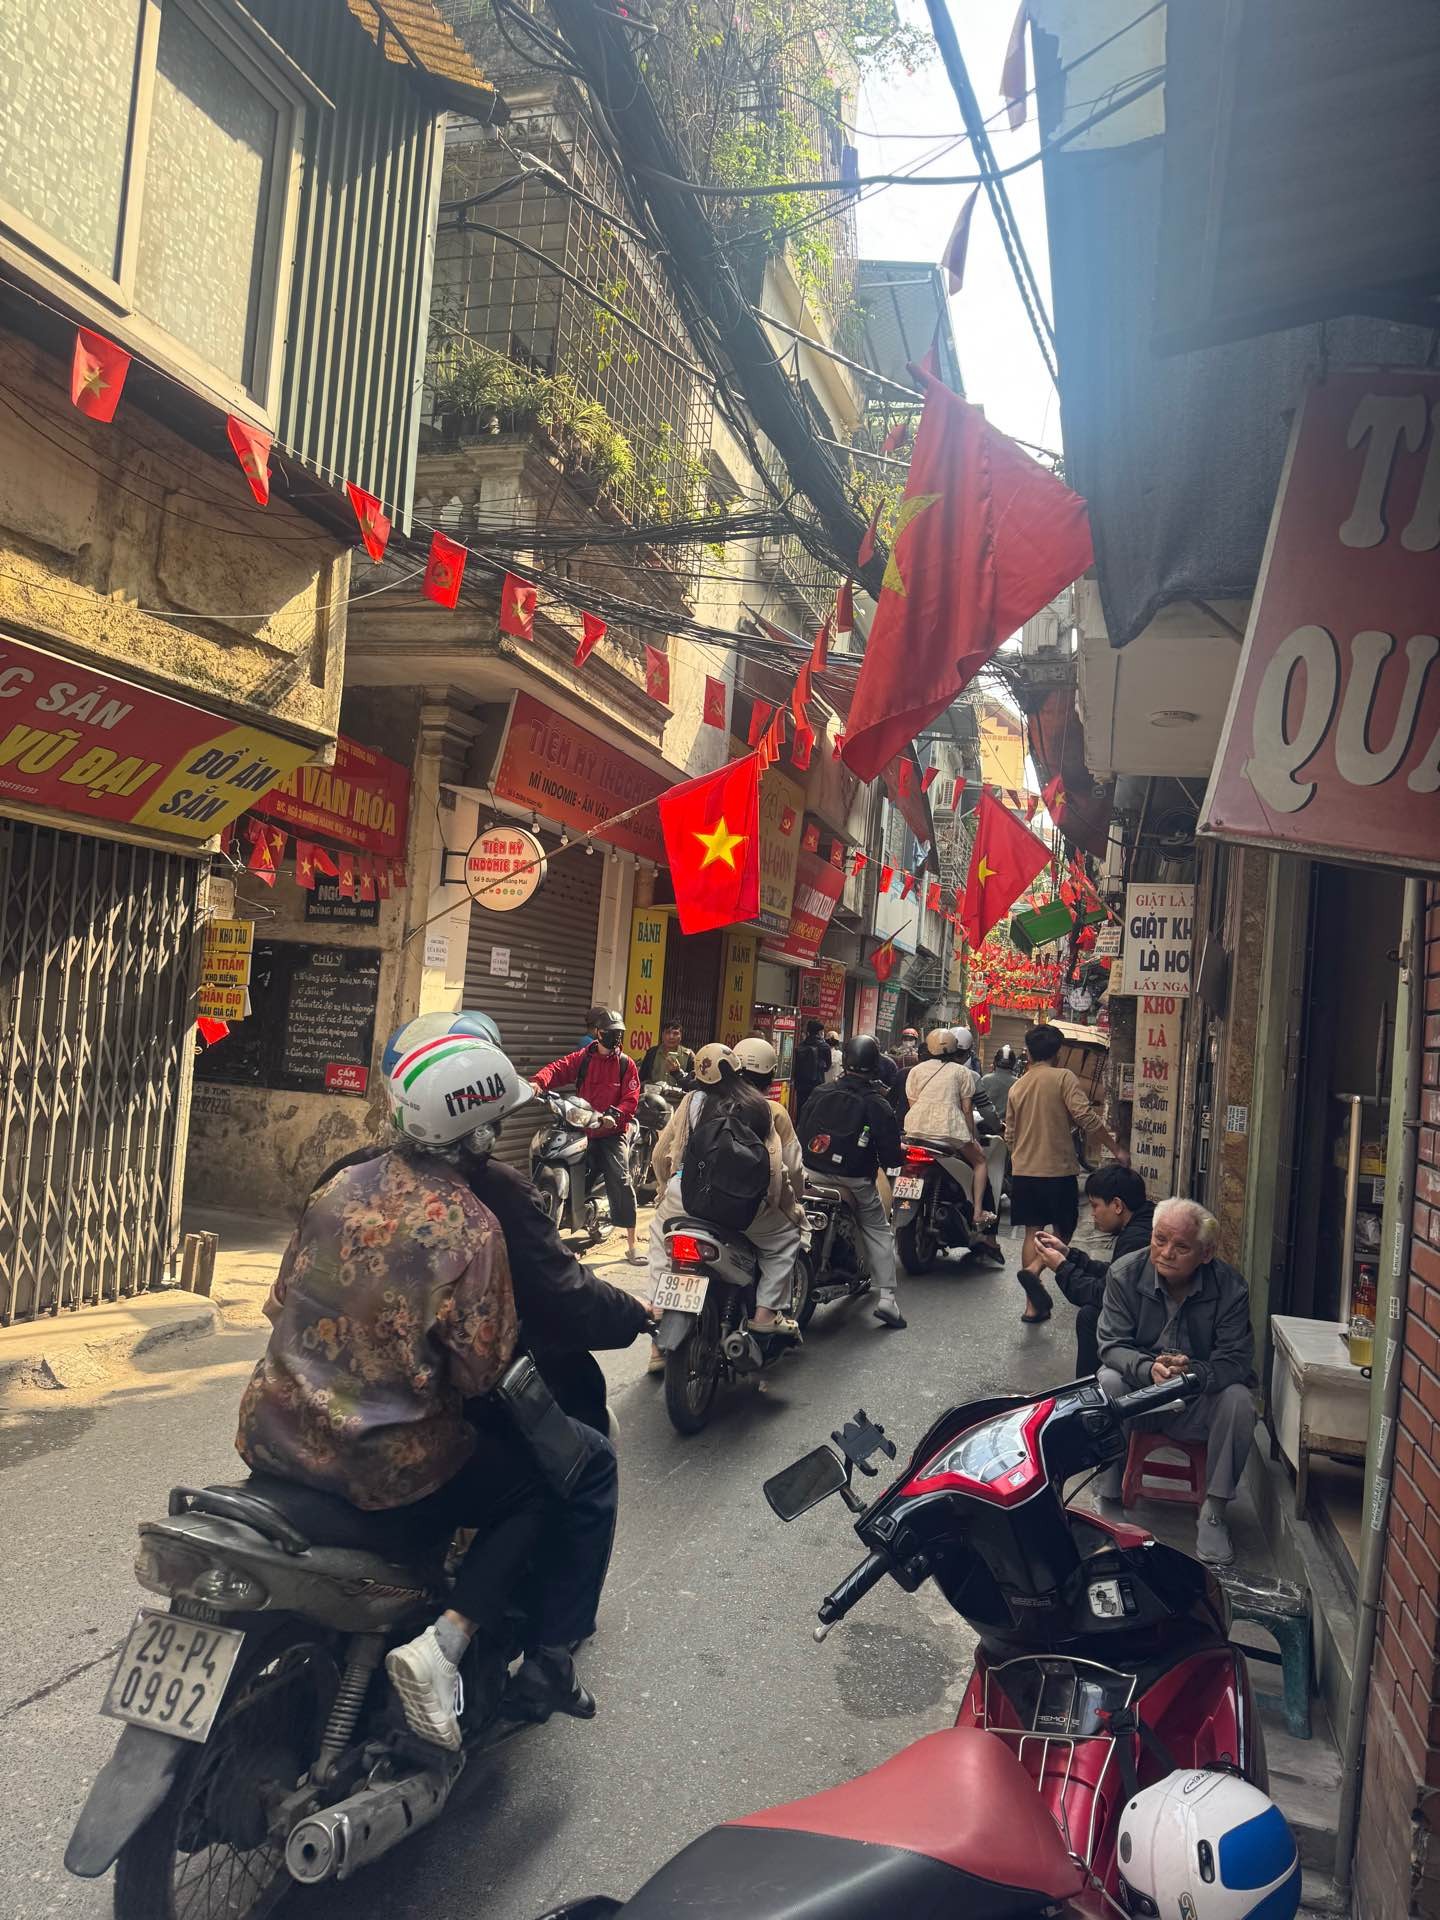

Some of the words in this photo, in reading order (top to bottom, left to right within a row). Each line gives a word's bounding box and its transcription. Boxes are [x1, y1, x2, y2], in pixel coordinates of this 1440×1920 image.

[36, 685, 135, 729] SẢN
[0, 724, 82, 774] VŨ
[59, 746, 163, 799] ĐẠI
[186, 748, 249, 780] ĐỒ
[226, 757, 280, 792] ĂN
[159, 785, 229, 822] SẴN
[528, 771, 540, 789] MÌ
[542, 779, 577, 807] INDOMIE
[581, 792, 594, 812] ĂN
[353, 788, 395, 836] HÓA
[1136, 892, 1166, 910] GIẶT
[1170, 892, 1186, 907] LÀ
[219, 927, 233, 943] KHO
[235, 926, 247, 944] TÀU
[637, 917, 661, 944] BÁNH
[1130, 912, 1168, 944] GIẶT
[1172, 917, 1193, 940] KH
[641, 953, 652, 978] MÌ
[1139, 944, 1160, 972] LÀ
[1165, 950, 1190, 973] HƠ
[1134, 977, 1160, 991] LẤY
[1162, 982, 1189, 992] NGA
[635, 990, 652, 1015] SÀI
[630, 1025, 652, 1050] GÒN
[1148, 1024, 1167, 1047] LÀ
[338, 1066, 356, 1078] CẤM
[344, 1078, 361, 1088] RÁC
[444, 1073, 507, 1117] ITALIA
[656, 1291, 701, 1310] 580.59
[136, 1620, 221, 1679] 29-P4
[120, 1665, 206, 1728] 0992
